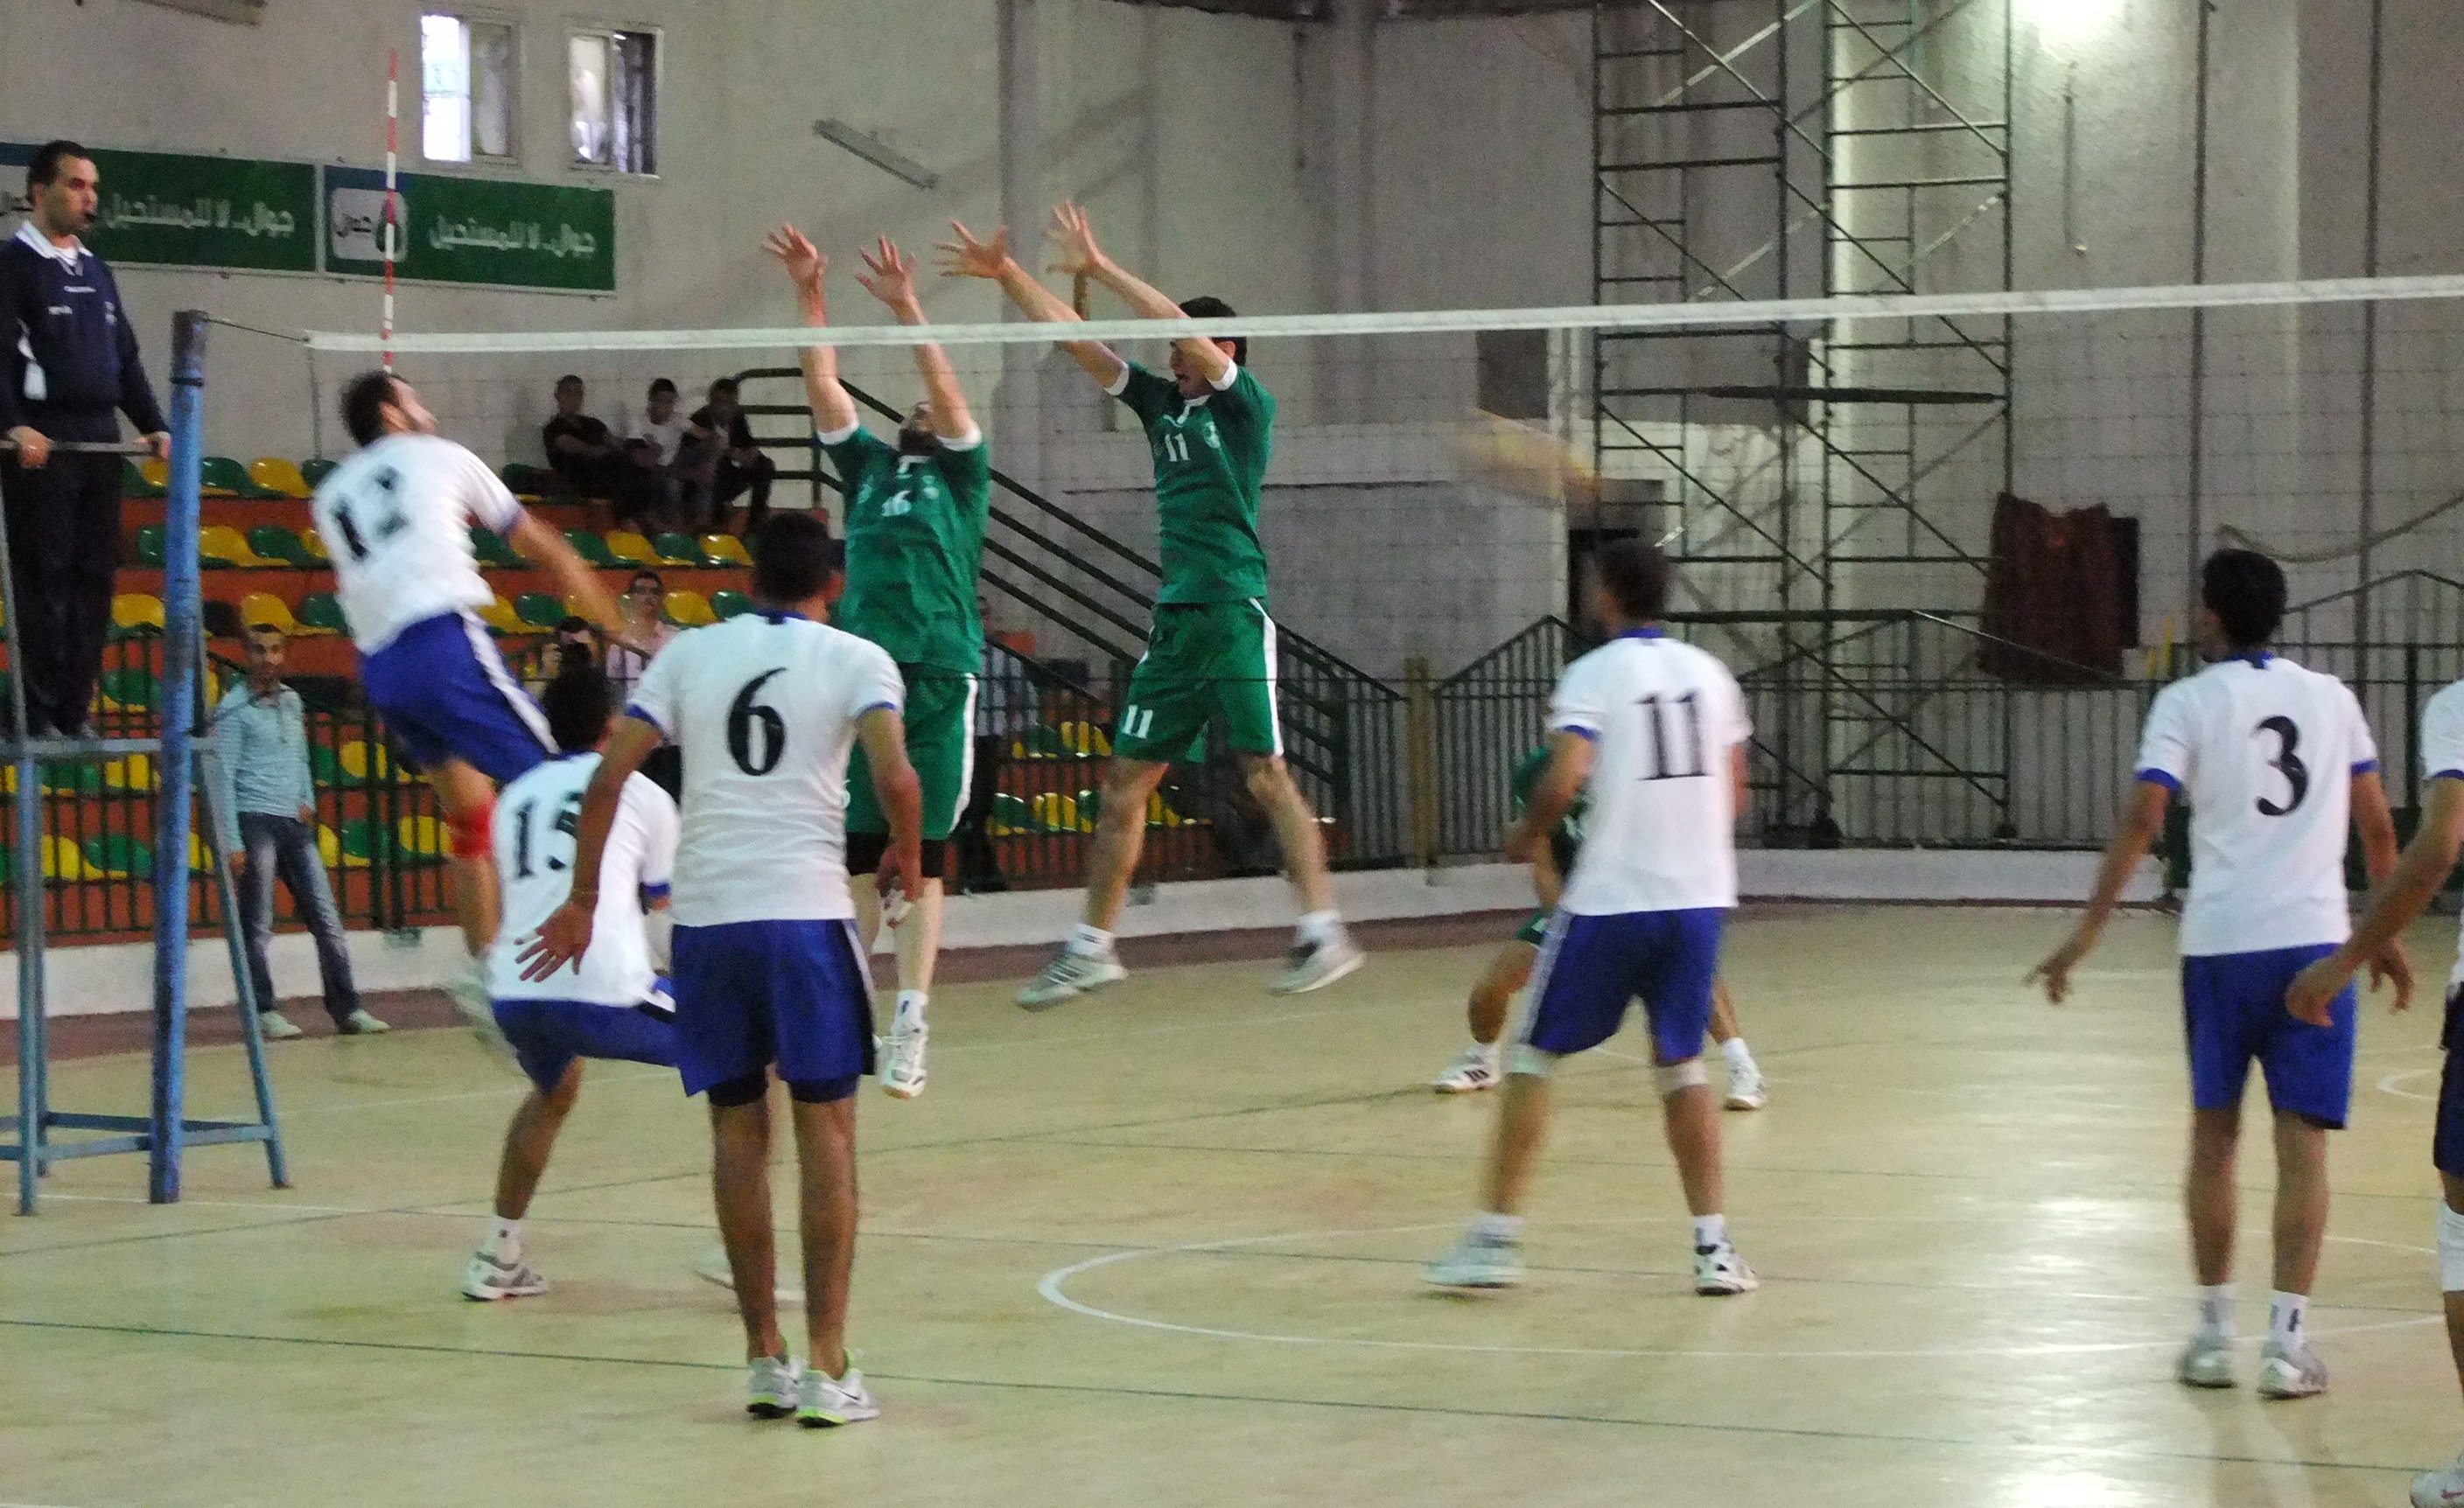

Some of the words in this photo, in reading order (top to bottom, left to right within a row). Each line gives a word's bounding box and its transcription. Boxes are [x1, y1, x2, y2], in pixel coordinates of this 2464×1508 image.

[1164, 432, 1191, 462] 11
[724, 667, 788, 777] 6
[1121, 704, 1154, 739] 11
[1633, 689, 1710, 781] 11
[2250, 716, 2309, 817] 3
